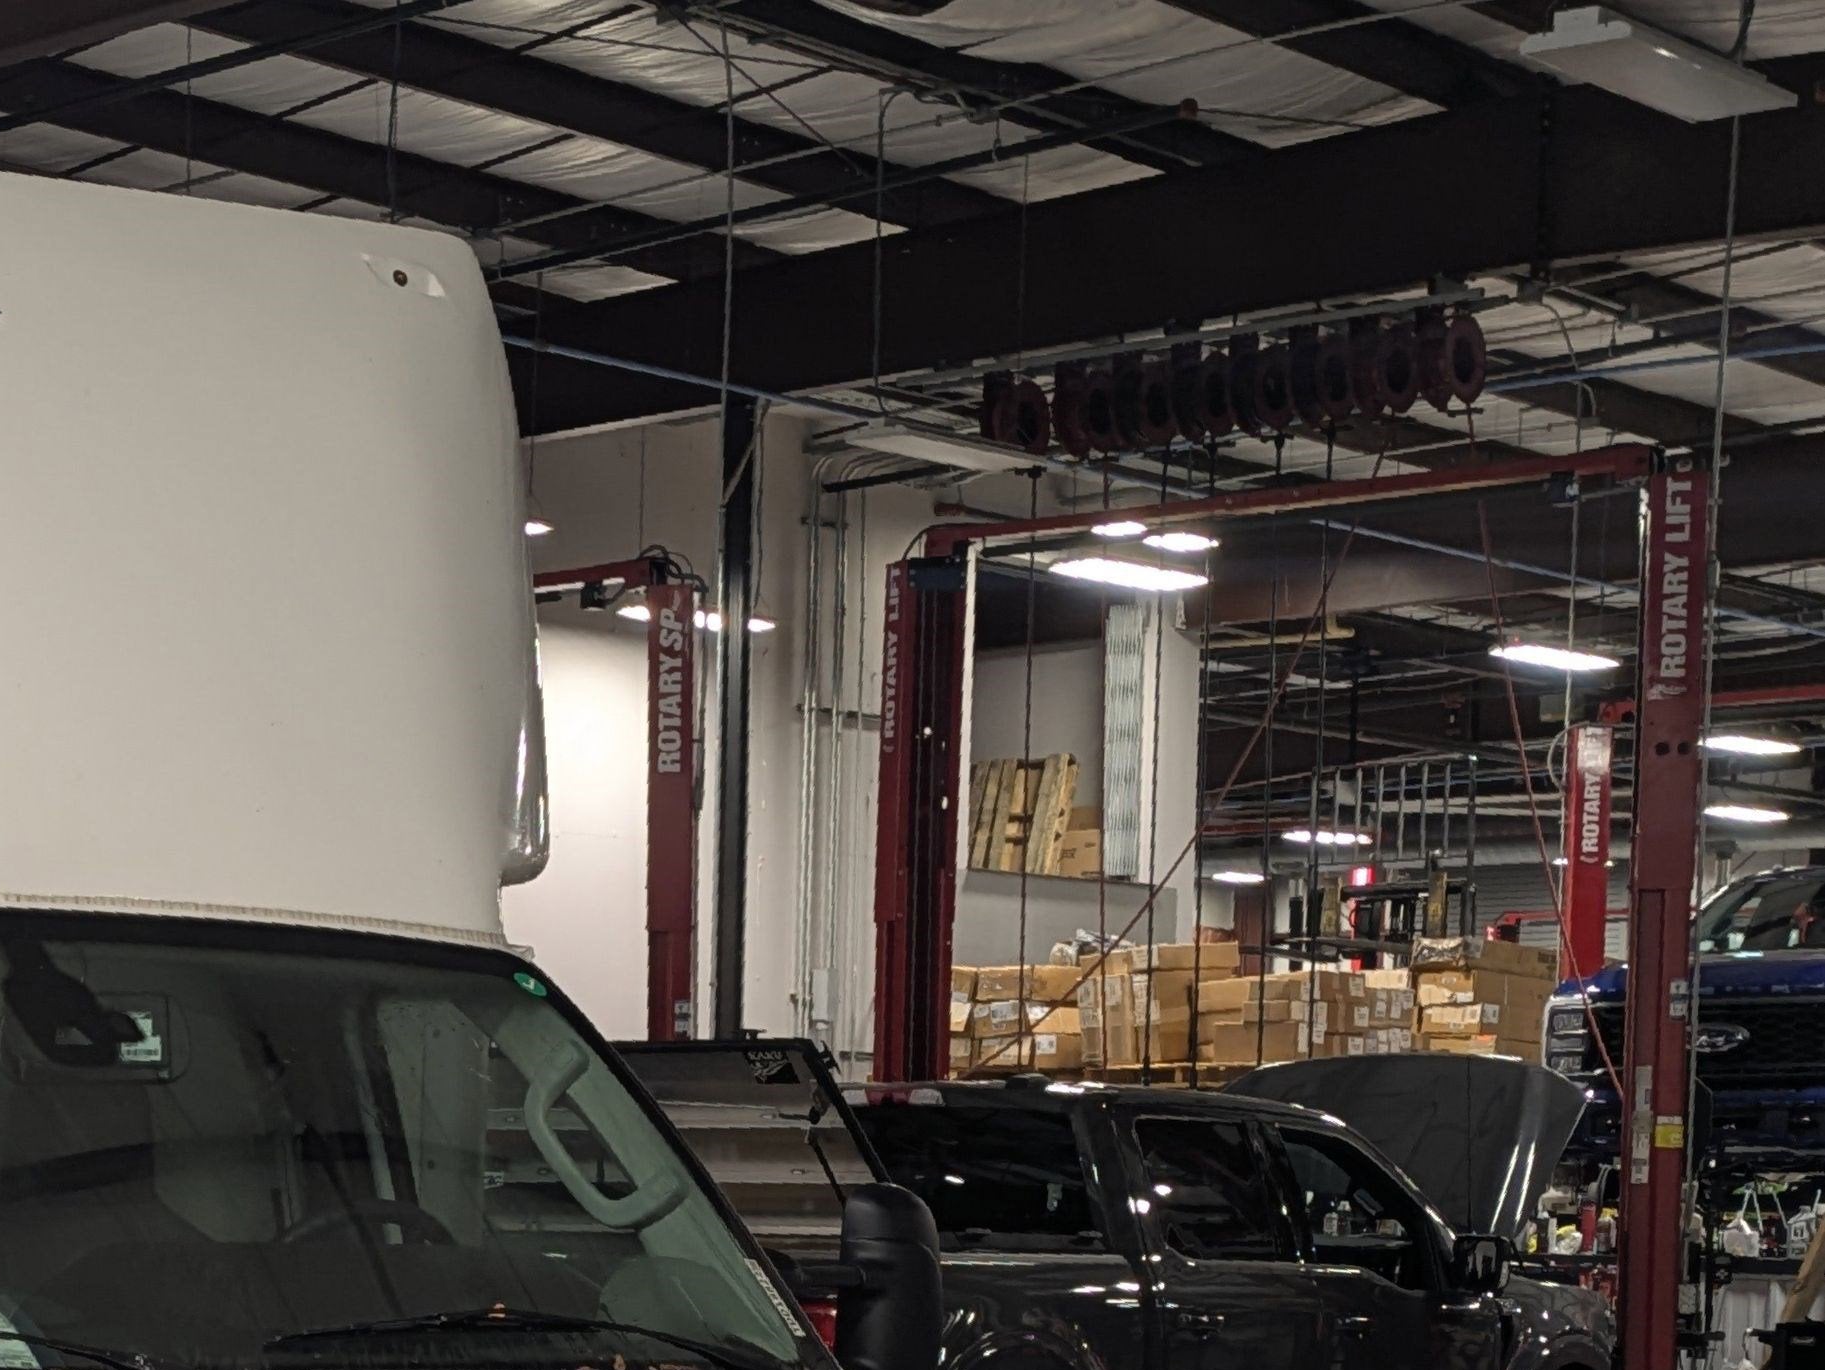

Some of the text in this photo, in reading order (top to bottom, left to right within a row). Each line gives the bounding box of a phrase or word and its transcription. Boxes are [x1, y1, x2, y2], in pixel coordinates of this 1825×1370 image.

[1660, 476, 1693, 678] ROTARY LIFT
[657, 652, 683, 774] ROTARY
[883, 565, 902, 739] ROTARY LIFT
[1580, 771, 1601, 853] ROTARY
